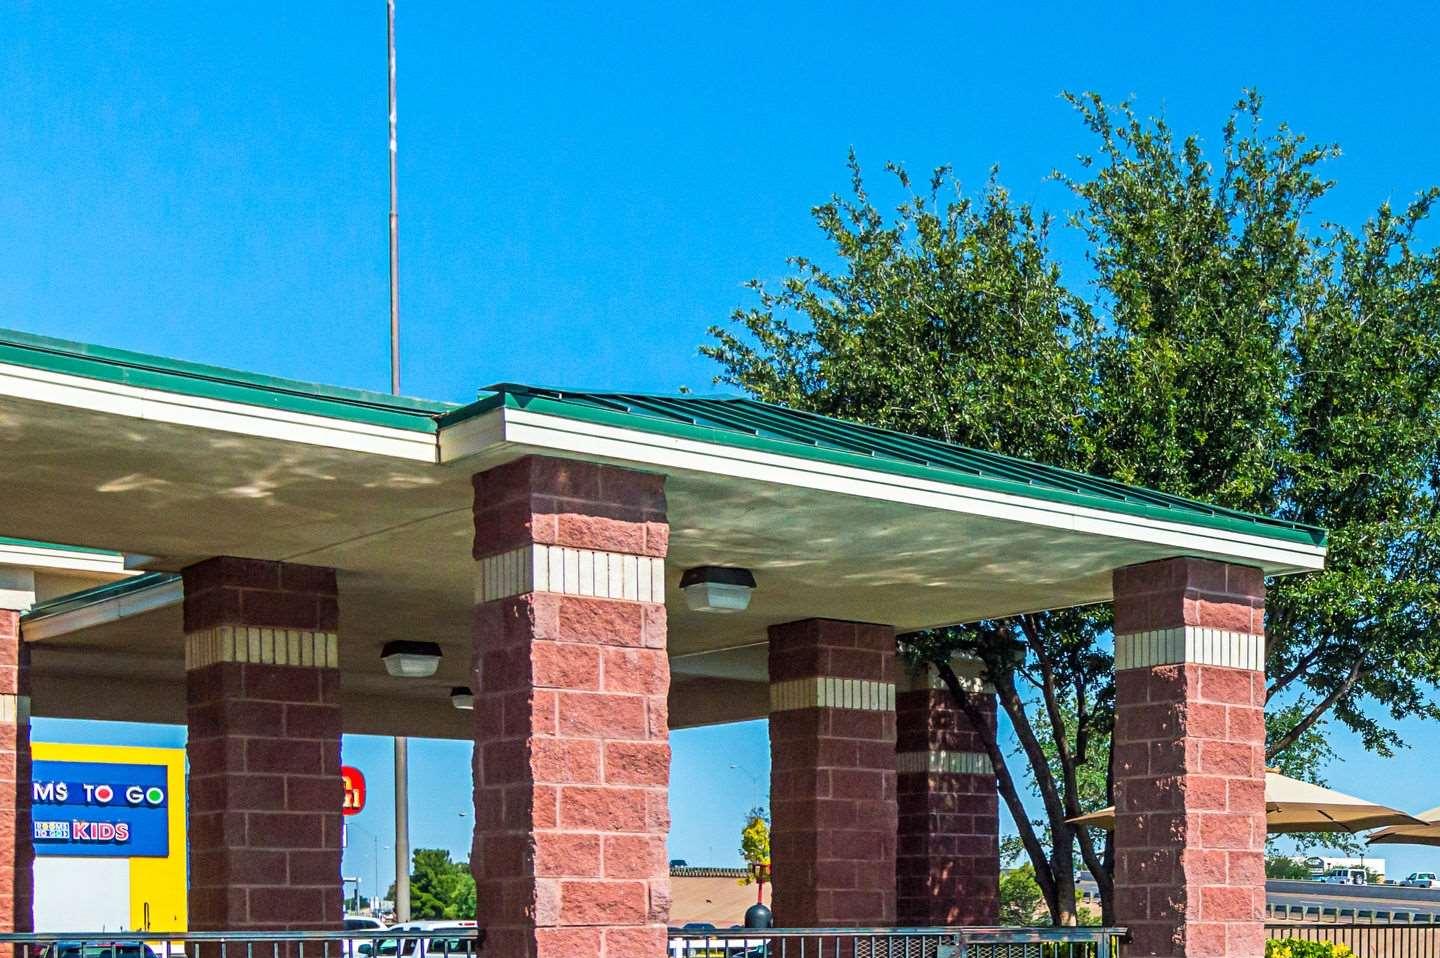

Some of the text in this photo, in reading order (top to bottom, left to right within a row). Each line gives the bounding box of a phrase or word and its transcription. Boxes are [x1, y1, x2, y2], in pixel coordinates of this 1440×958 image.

[83, 783, 113, 803] TO
[126, 786, 164, 805] GO
[72, 821, 130, 842] KIDS
